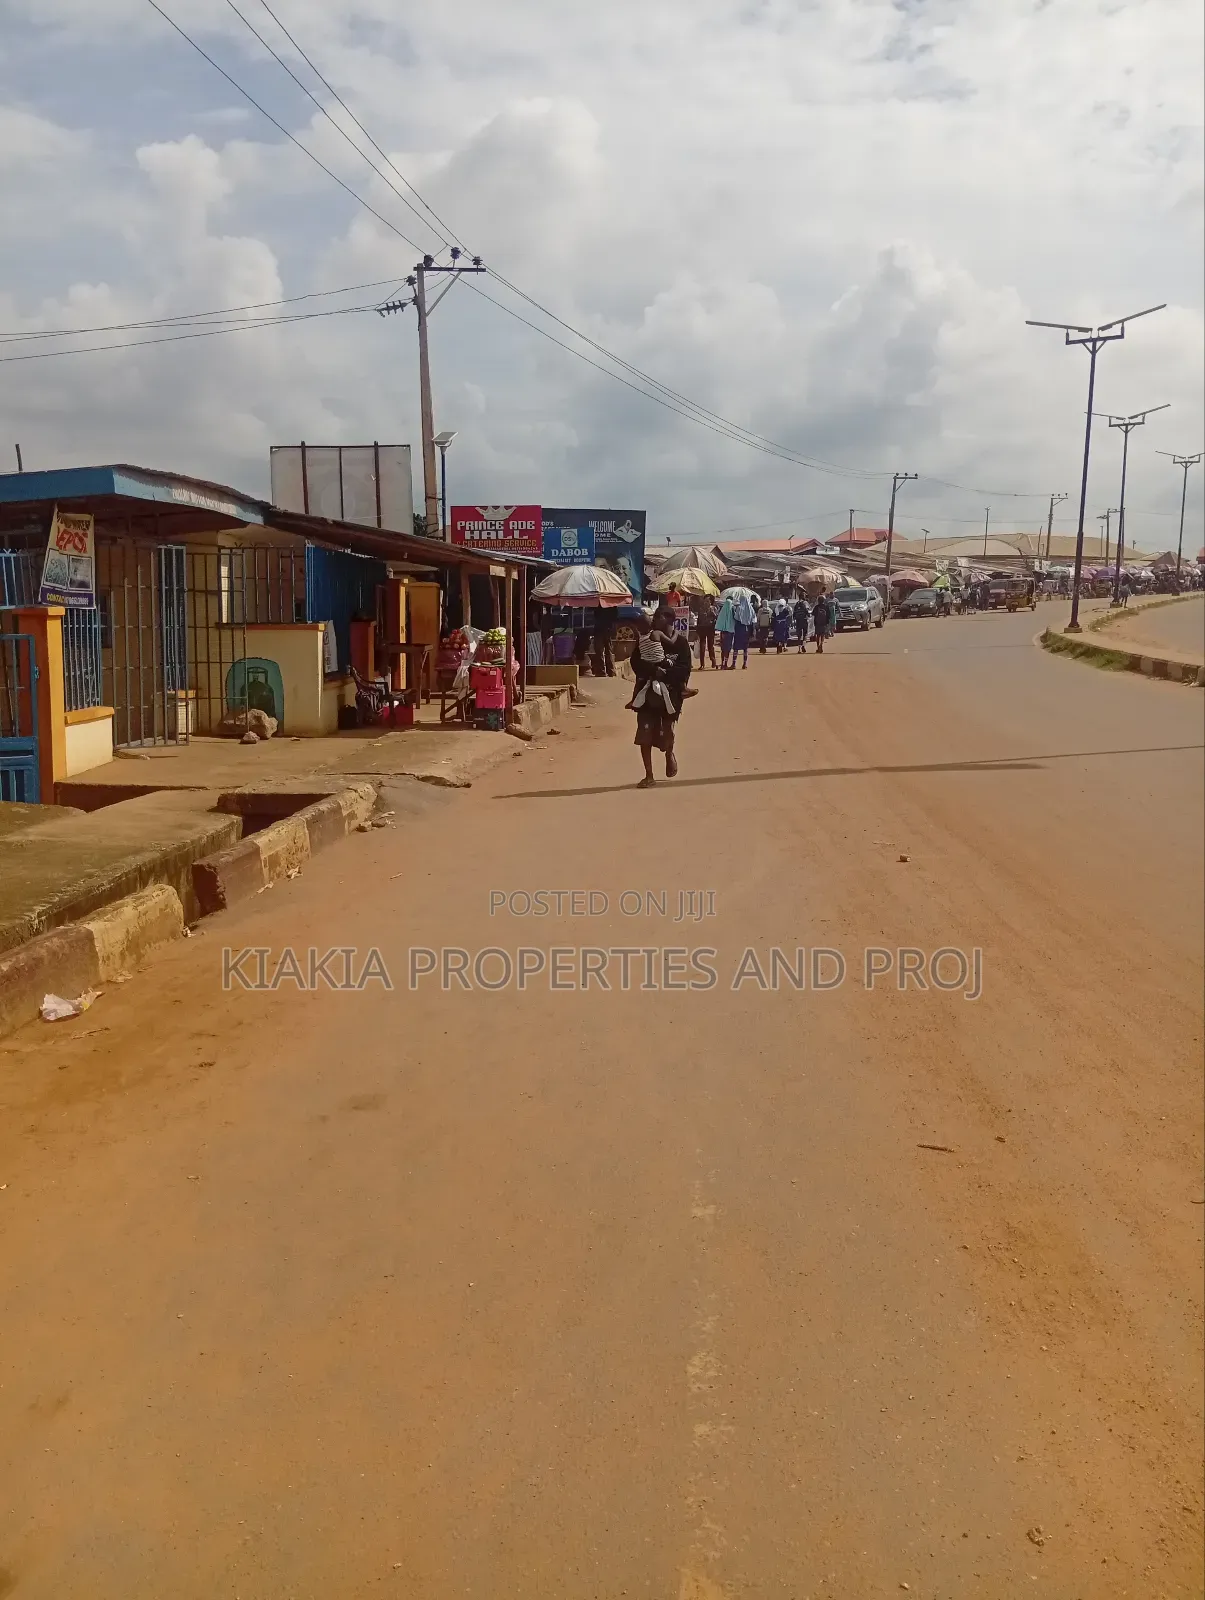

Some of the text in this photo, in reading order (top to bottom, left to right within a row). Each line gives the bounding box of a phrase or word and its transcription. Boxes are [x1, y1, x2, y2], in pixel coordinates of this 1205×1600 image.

[457, 520, 535, 530] PRINCE ADE
[588, 520, 616, 533] WELCOME
[464, 530, 528, 540] HALL
[462, 540, 502, 548] CATERING
[504, 539, 537, 547] SERVICE
[551, 548, 589, 557] DABOB
